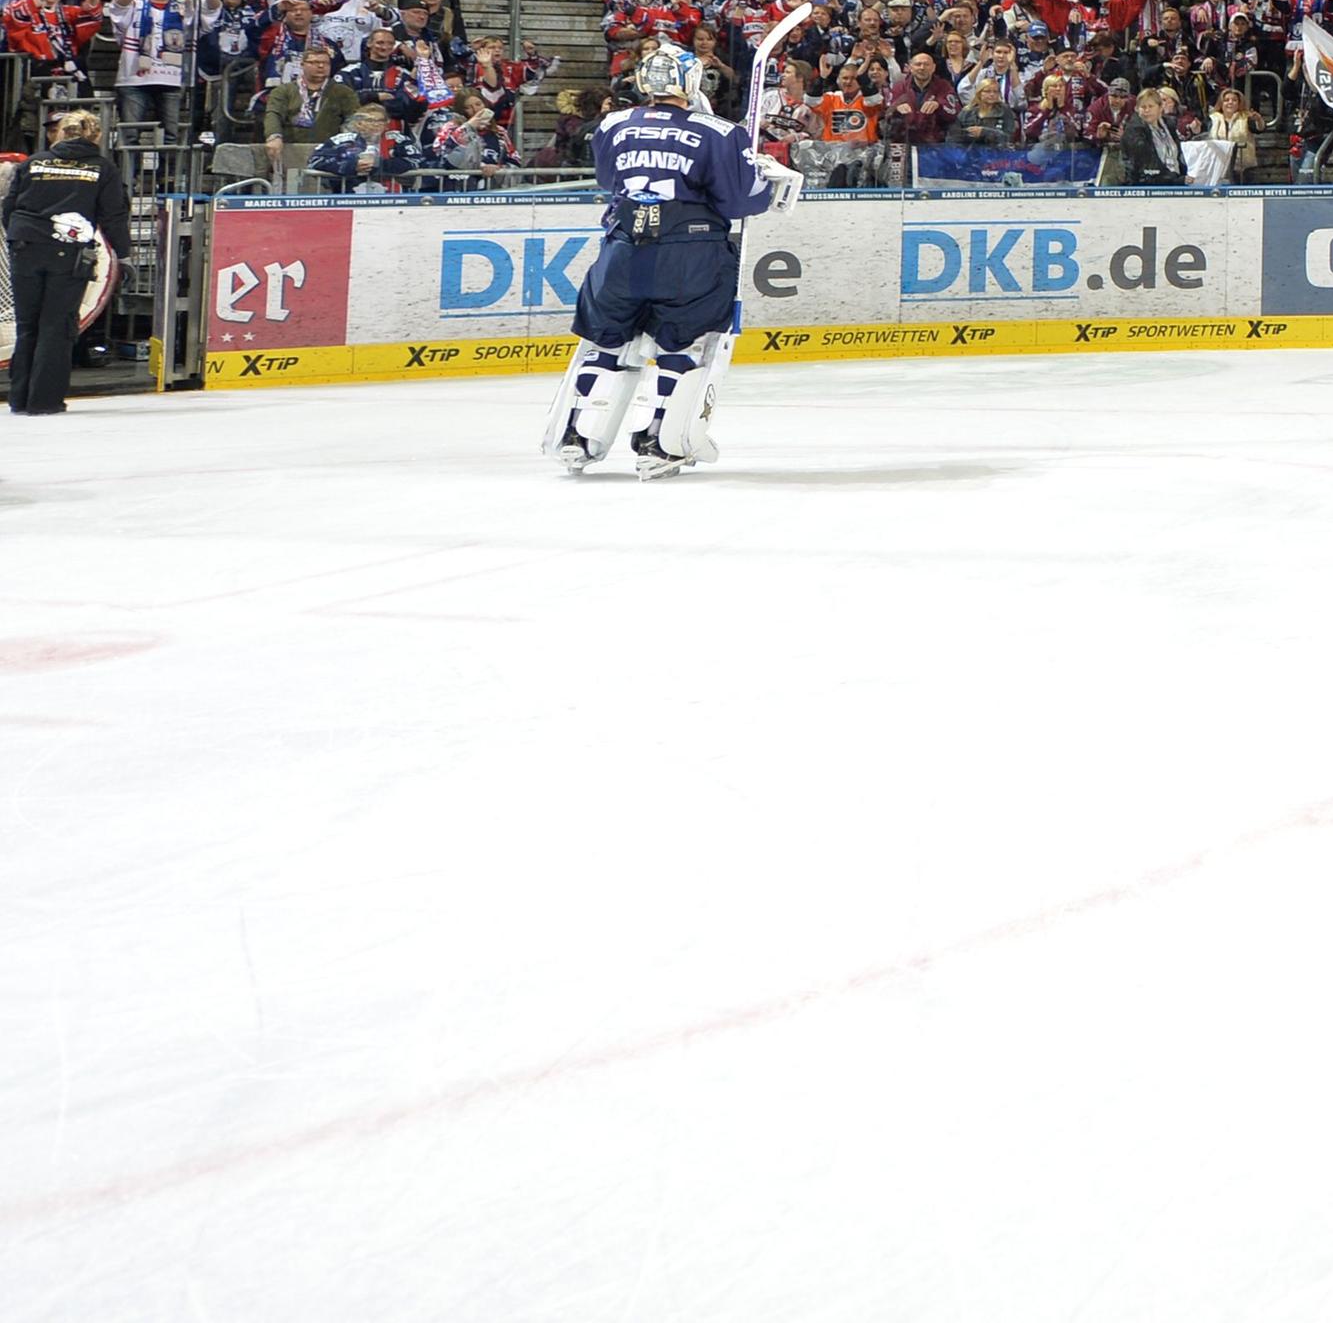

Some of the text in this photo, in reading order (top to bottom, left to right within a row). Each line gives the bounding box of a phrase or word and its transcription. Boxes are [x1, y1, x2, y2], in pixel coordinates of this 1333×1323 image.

[612, 126, 703, 149] GASAG
[615, 149, 695, 176] EHANEN
[244, 199, 282, 209] MARCEL
[282, 198, 329, 208] TEICHERT
[446, 196, 466, 205] ANNE
[1093, 189, 1122, 197] MARCEL
[1228, 188, 1287, 197] CHRISTIAN MEYER
[901, 227, 1208, 295] DKB.de
[763, 324, 996, 352] X-TiP SPORTWETTEN X-TiP
[1075, 319, 1288, 343] X-TiP SPORTWETTEN X-TiP
[240, 353, 300, 377] X-TiP
[405, 341, 574, 369] X-TiP SPORTWET
